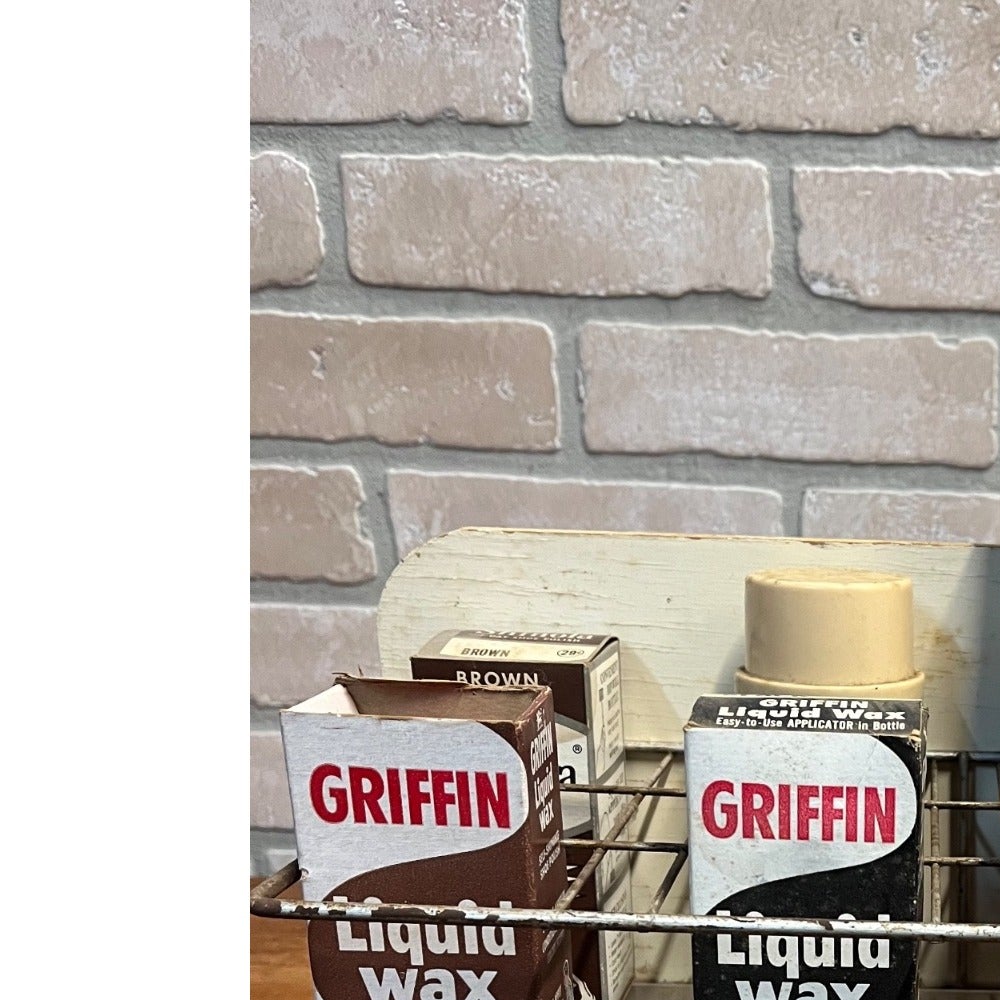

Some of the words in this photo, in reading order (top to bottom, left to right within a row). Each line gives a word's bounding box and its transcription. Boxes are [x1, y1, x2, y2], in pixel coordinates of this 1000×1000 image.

[461, 648, 510, 658] BROWN
[456, 670, 539, 686] BROWN
[718, 706, 822, 720] Liquid
[833, 709, 905, 720] Wax
[759, 698, 868, 709] GRIFFIN
[716, 717, 782, 729] Easy-to-Use
[787, 718, 853, 730] APPLICATOR
[858, 721, 868, 730] in
[873, 721, 905, 731] Bottle
[530, 721, 554, 775] GRIFFIN
[309, 763, 511, 829] GRIFFIN
[534, 762, 554, 809] Liquid
[538, 799, 555, 832] wax
[701, 779, 896, 844] GRIFFIN
[332, 896, 516, 966] Liquid
[716, 910, 890, 979] Liquid
